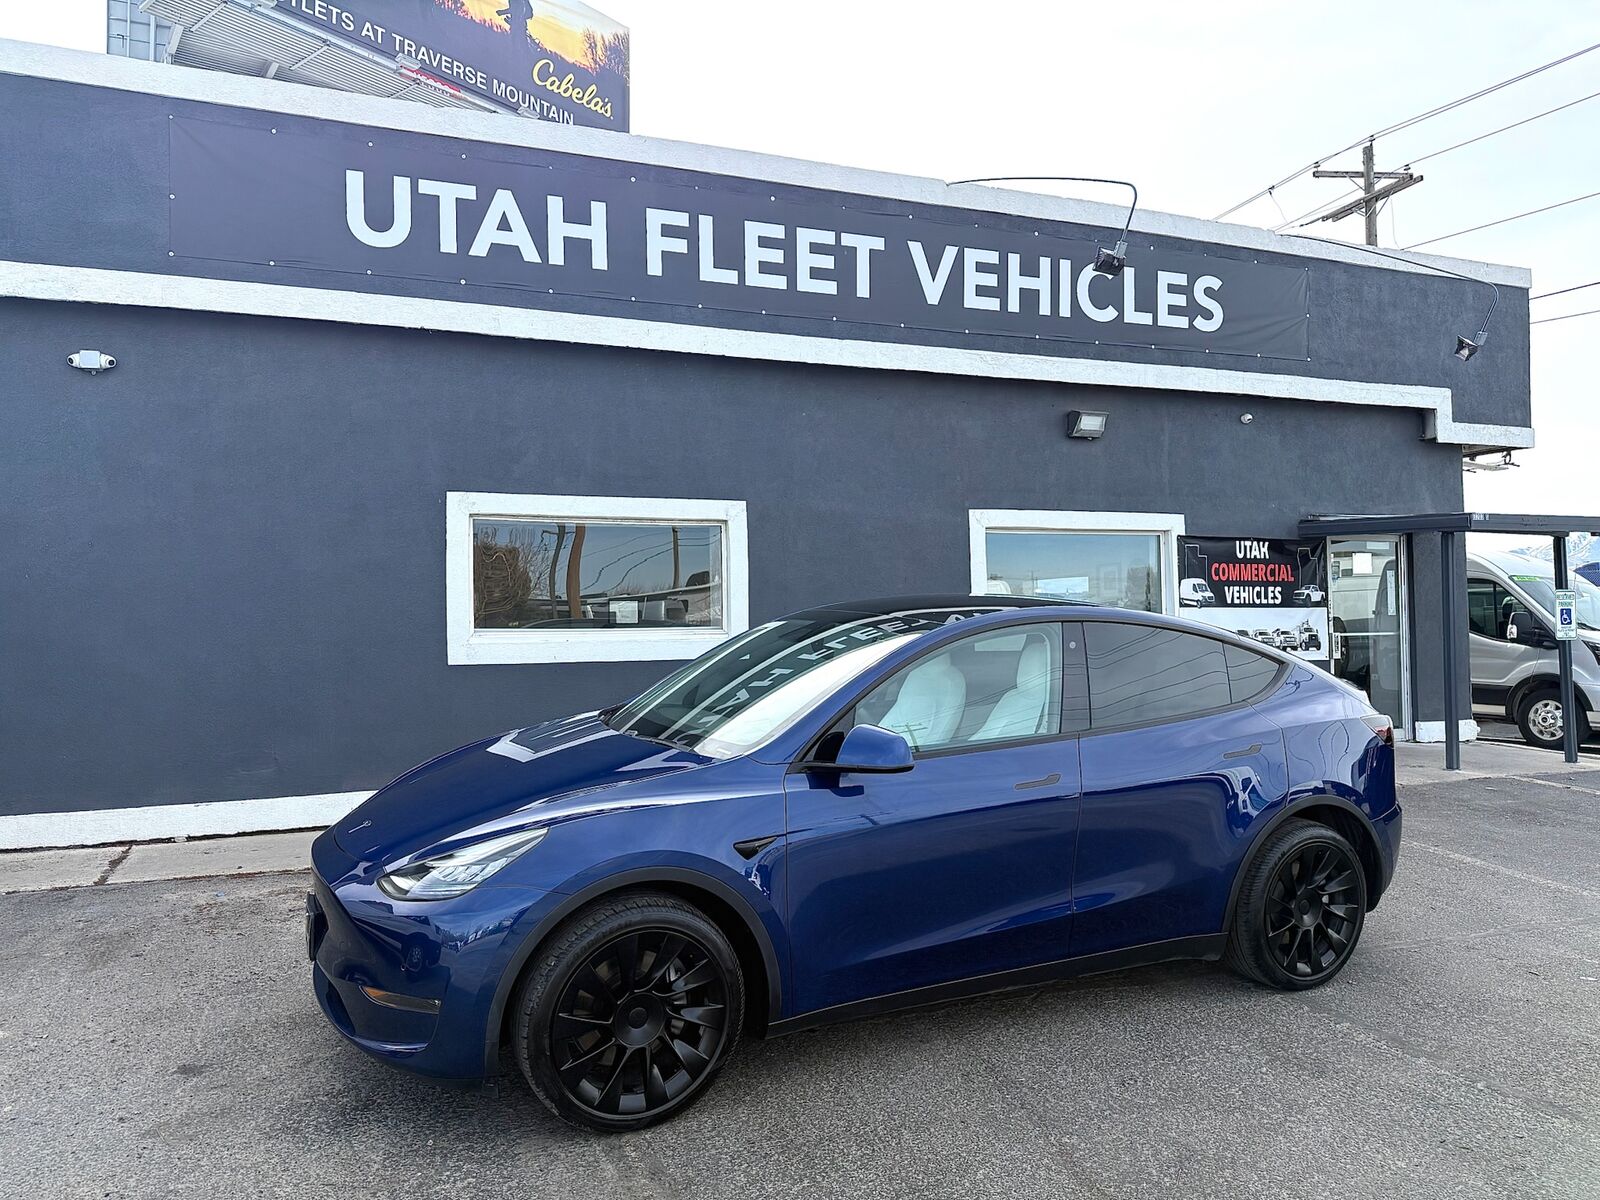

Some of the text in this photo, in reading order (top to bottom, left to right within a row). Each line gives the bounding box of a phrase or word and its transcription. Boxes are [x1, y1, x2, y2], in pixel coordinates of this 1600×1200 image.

[361, 22, 386, 44] AT
[391, 33, 488, 91] TRAVERSE
[493, 79, 574, 125] MOUNTAIN
[532, 59, 614, 119] Cabela's
[345, 169, 1224, 333] UTAH FLEET VEHICLES
[1211, 562, 1295, 582] COMMERCIAL
[1224, 586, 1282, 605] VEHICLES
